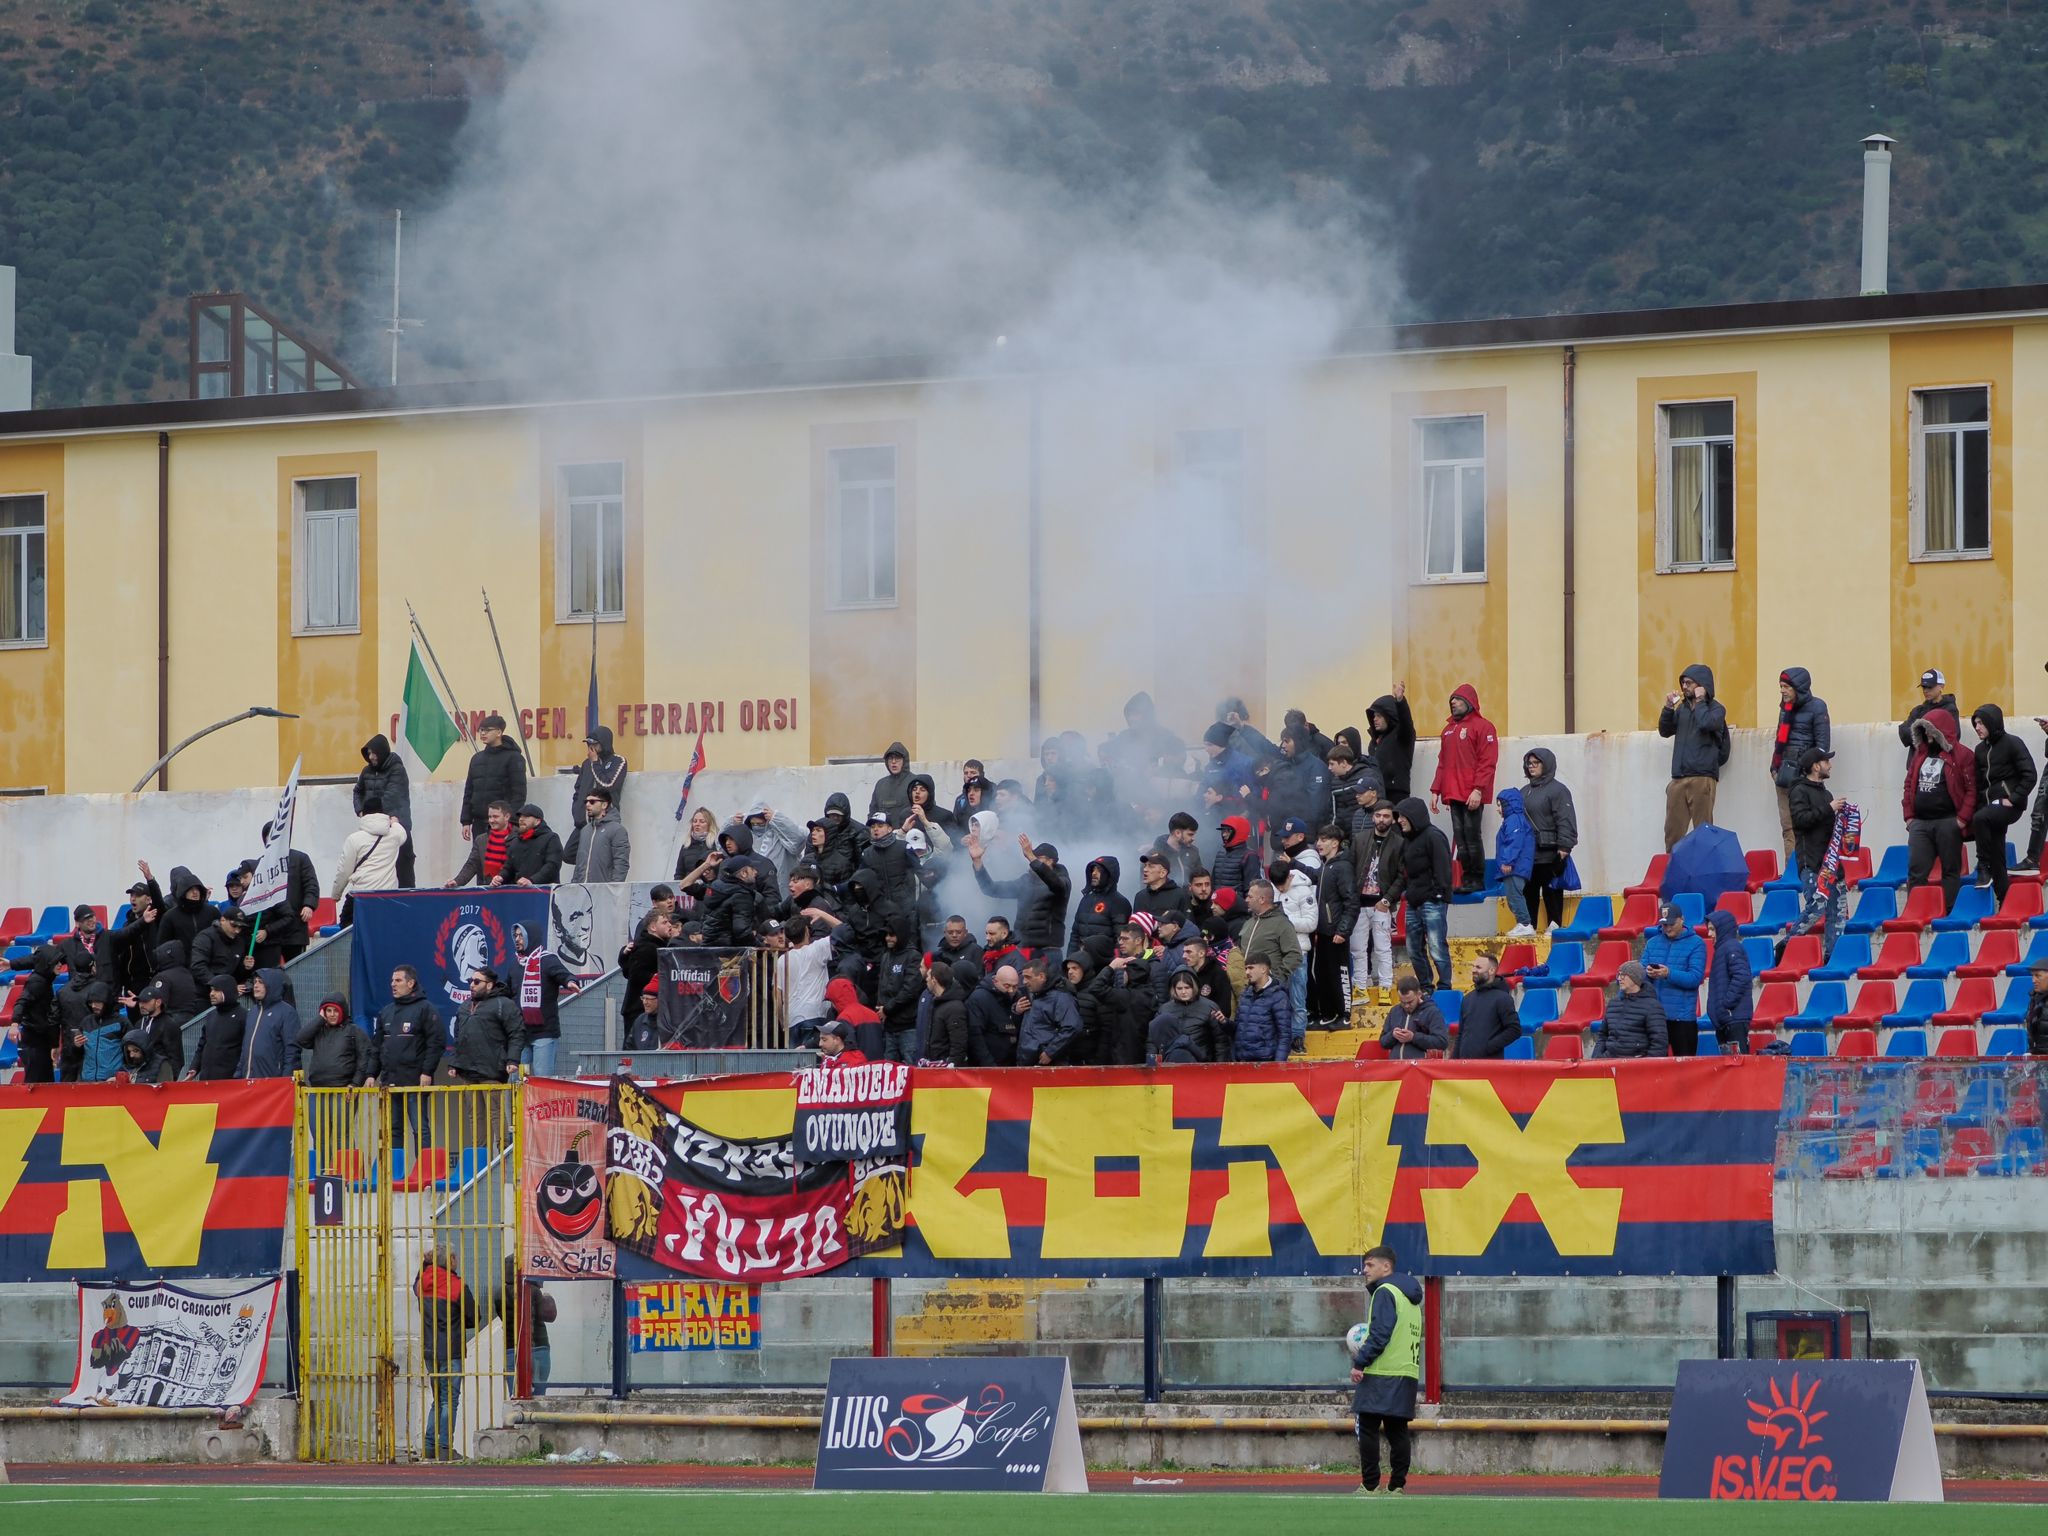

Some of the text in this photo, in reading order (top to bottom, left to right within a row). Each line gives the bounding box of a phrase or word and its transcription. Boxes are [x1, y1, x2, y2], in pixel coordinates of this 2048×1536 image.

[617, 701, 724, 737] FERRARI
[740, 697, 797, 732] ORSI
[460, 904, 480, 915] 2017
[671, 969, 711, 982] Diffidati
[798, 1062, 909, 1104] EMANUELE
[577, 1098, 608, 1124] BRON
[806, 1110, 897, 1155] OVUNQUE
[561, 1246, 612, 1274] Girls
[128, 1292, 231, 1317] CLUB AMICI CASAGIOVE
[638, 1283, 750, 1320] CURVA
[825, 1395, 889, 1450] LUIS
